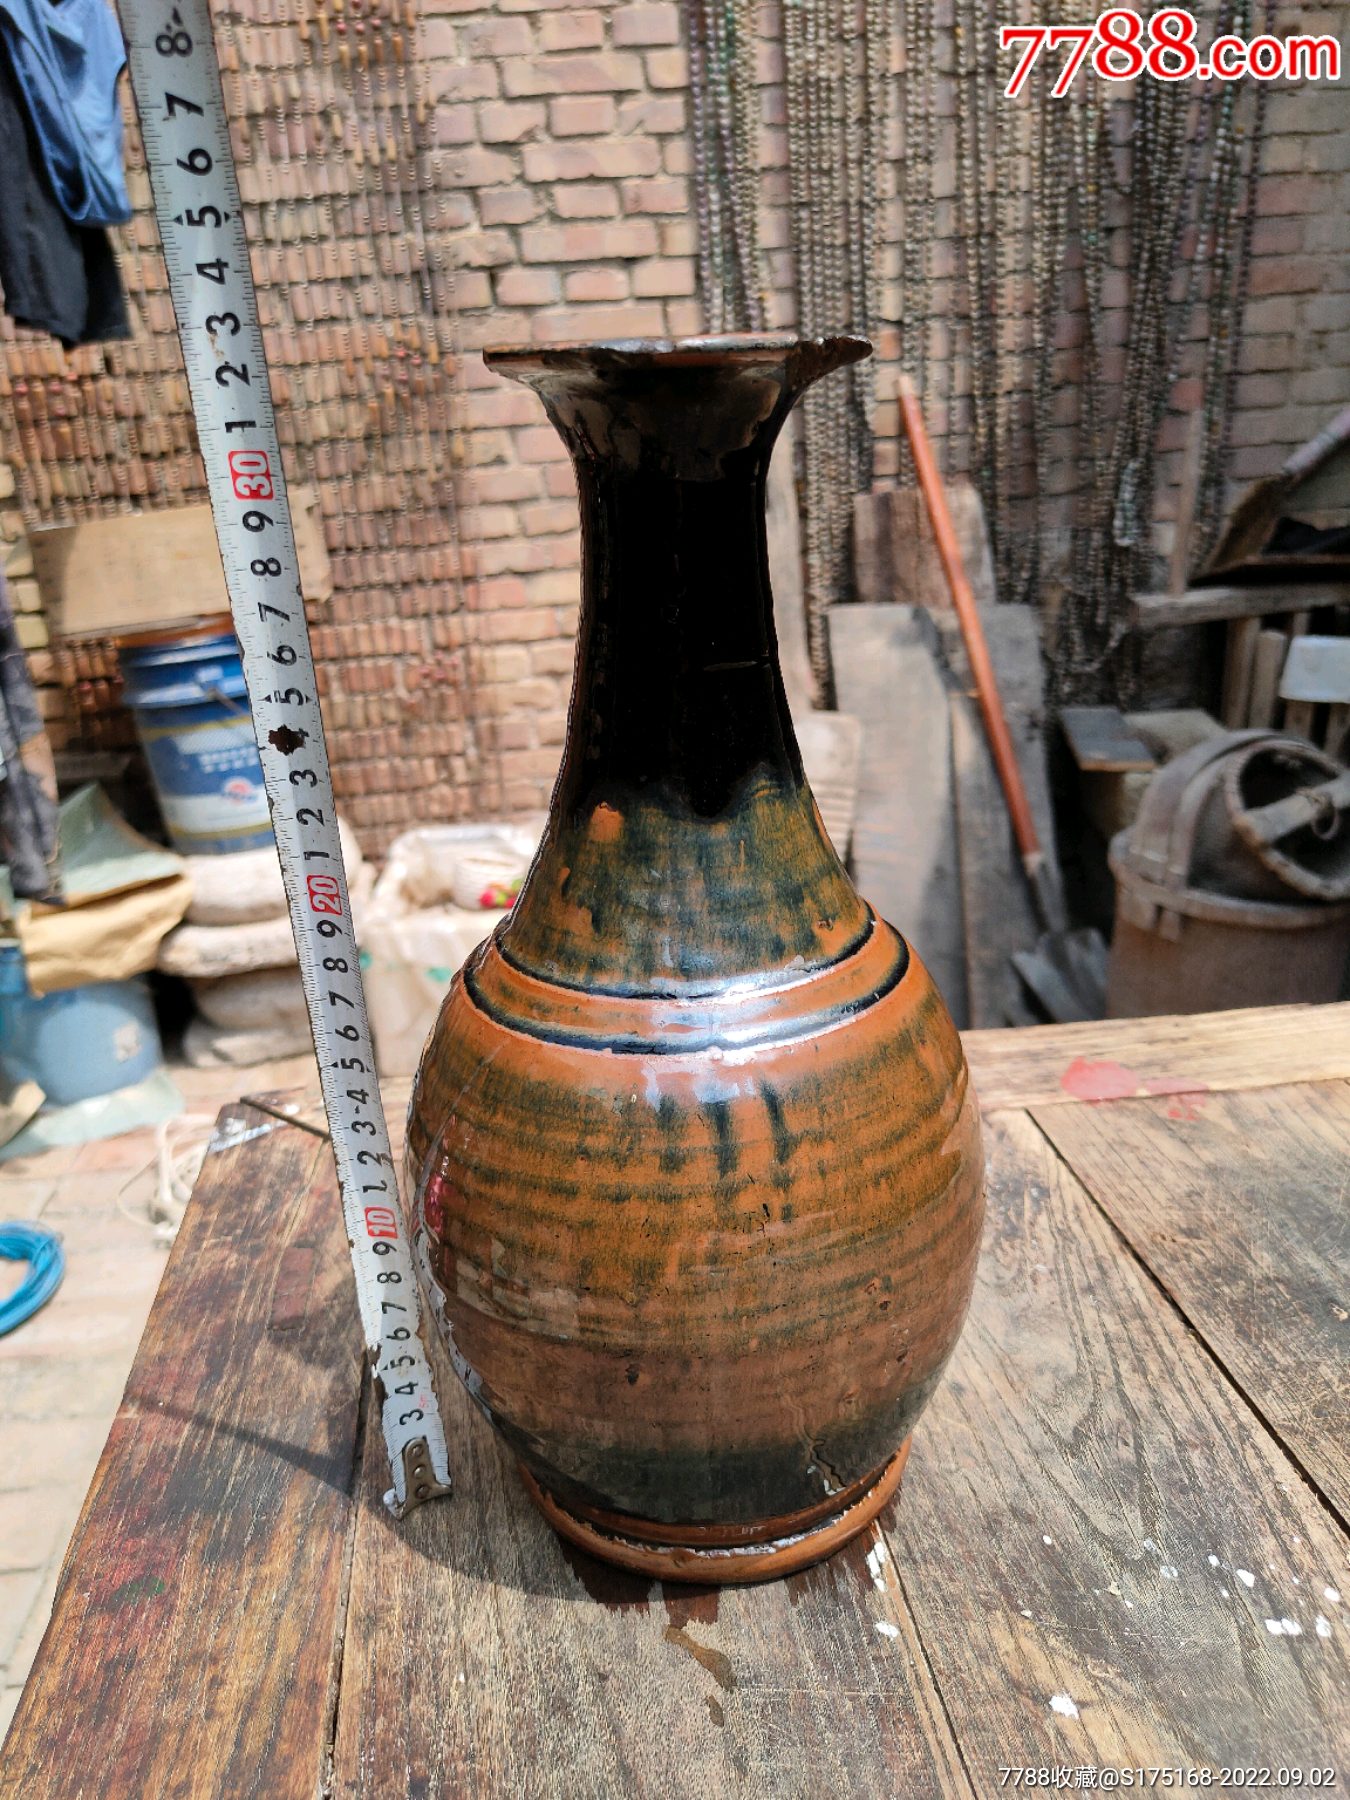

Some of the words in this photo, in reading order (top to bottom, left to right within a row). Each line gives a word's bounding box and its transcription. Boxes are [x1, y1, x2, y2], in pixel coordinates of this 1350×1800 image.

[156, 32, 193, 57] 8
[163, 92, 204, 121] 7
[177, 148, 213, 176] 6
[185, 206, 222, 228] 5
[196, 258, 229, 285] 4
[205, 312, 240, 336] 3
[215, 361, 250, 387] 2
[225, 420, 257, 433] 1
[230, 452, 272, 497] 30
[242, 510, 273, 533] 9
[251, 557, 282, 577] 8
[258, 602, 290, 622] 7
[267, 645, 297, 666] 6
[274, 688, 304, 706] 5
[290, 769, 317, 788] 3
[296, 808, 325, 826] 2
[304, 851, 330, 860] 1
[310, 877, 340, 913] 20
[316, 920, 342, 938] 9
[323, 957, 348, 974] 8
[329, 990, 355, 1009] 7
[335, 1025, 360, 1042] 6
[341, 1058, 365, 1073] 5
[347, 1088, 369, 1106] 4
[352, 1120, 377, 1136] 3
[357, 1151, 382, 1166] 2
[363, 1179, 388, 1193] 1
[368, 1210, 396, 1237] 10
[372, 1241, 397, 1256] 9
[377, 1271, 402, 1284] 8
[381, 1301, 407, 1314] 7
[386, 1327, 411, 1342] 6
[390, 1355, 415, 1370] 5
[394, 1381, 419, 1396] 4
[400, 1408, 424, 1425] 3
